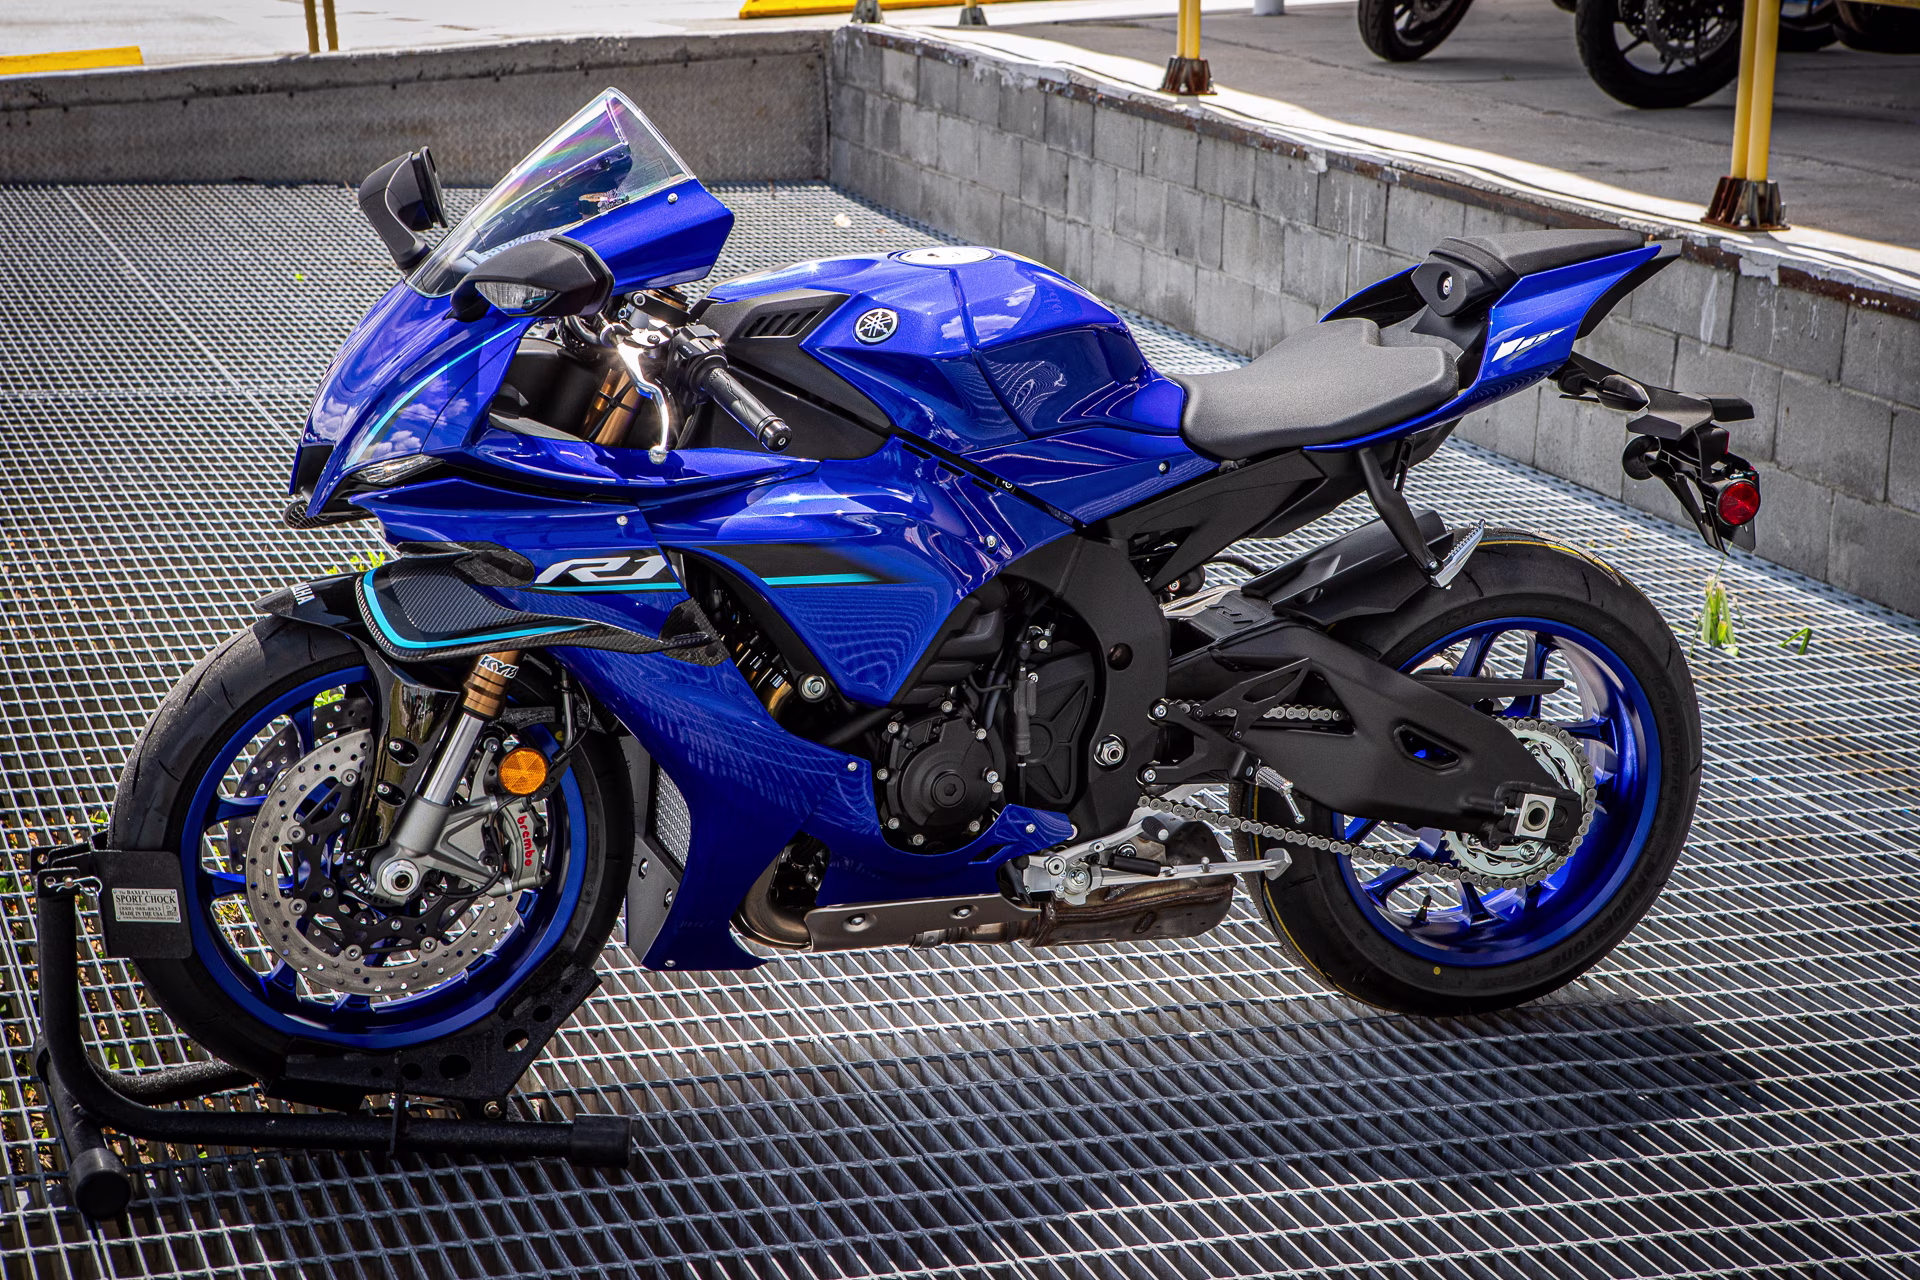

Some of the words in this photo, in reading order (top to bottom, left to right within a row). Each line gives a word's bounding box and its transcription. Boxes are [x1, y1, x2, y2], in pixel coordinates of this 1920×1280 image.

[534, 555, 667, 583] R1
[478, 653, 520, 679] KYB
[516, 815, 537, 867] brembo
[116, 895, 143, 903] SPORT
[145, 895, 176, 904] CHOCK
